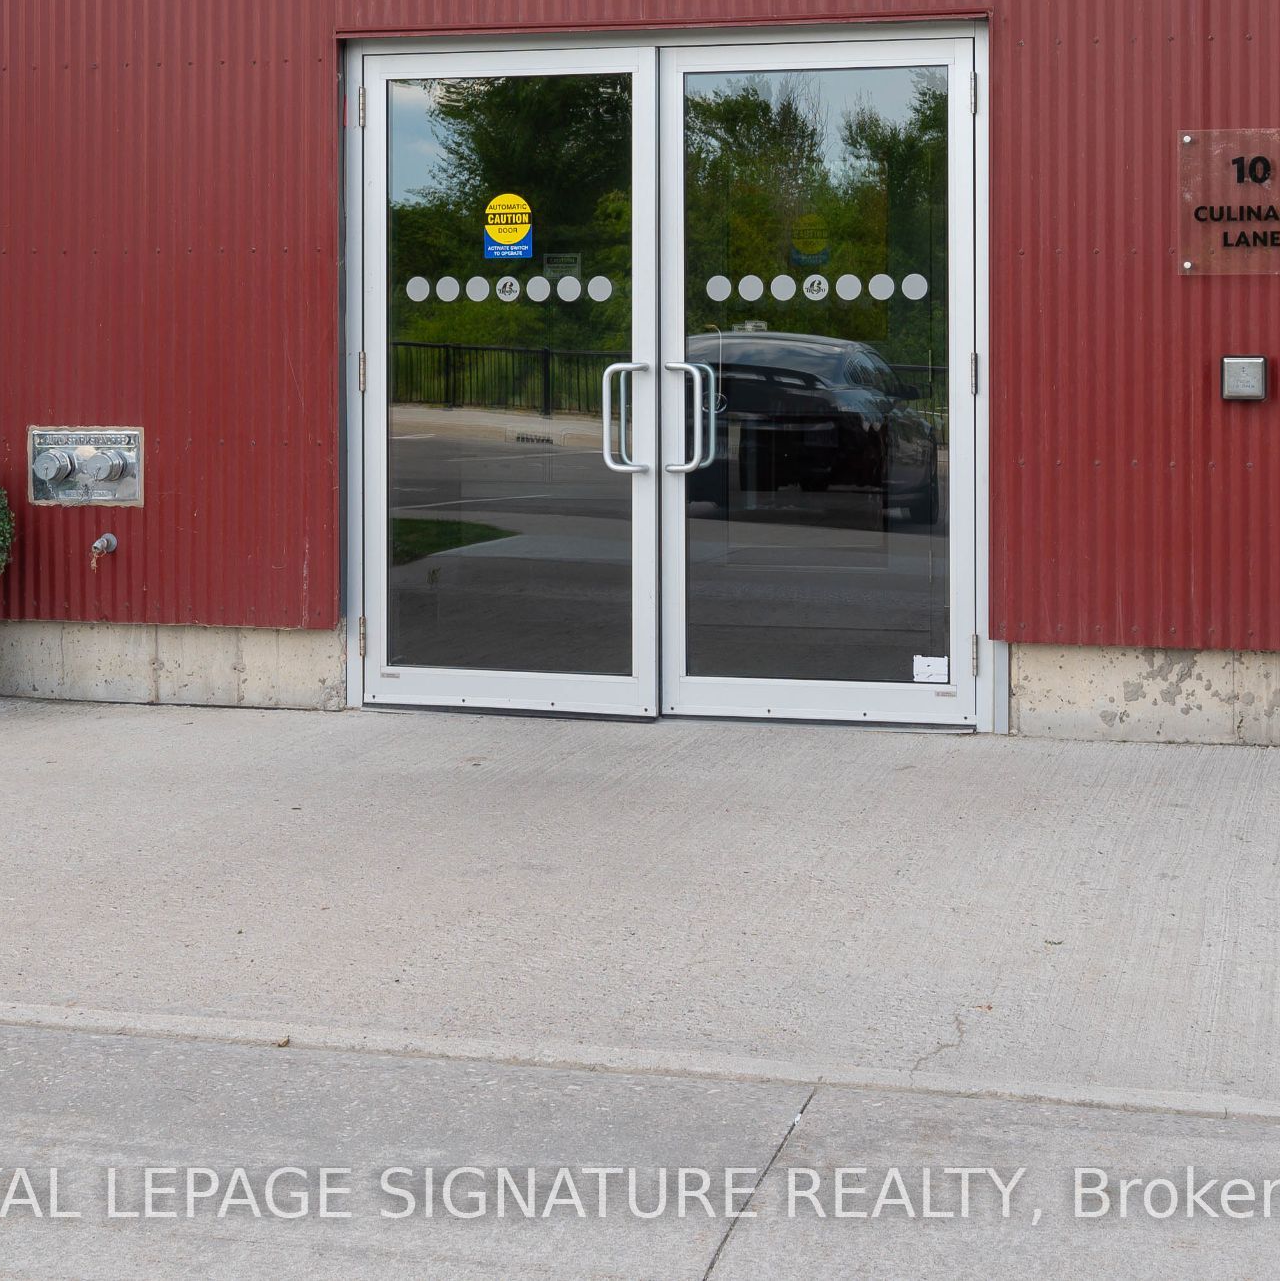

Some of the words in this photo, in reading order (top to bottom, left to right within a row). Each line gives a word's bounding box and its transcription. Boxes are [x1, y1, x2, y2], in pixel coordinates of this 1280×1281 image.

[1232, 156, 1271, 183] 10
[488, 214, 528, 224] CAUTION
[1223, 231, 1280, 247] LANE
